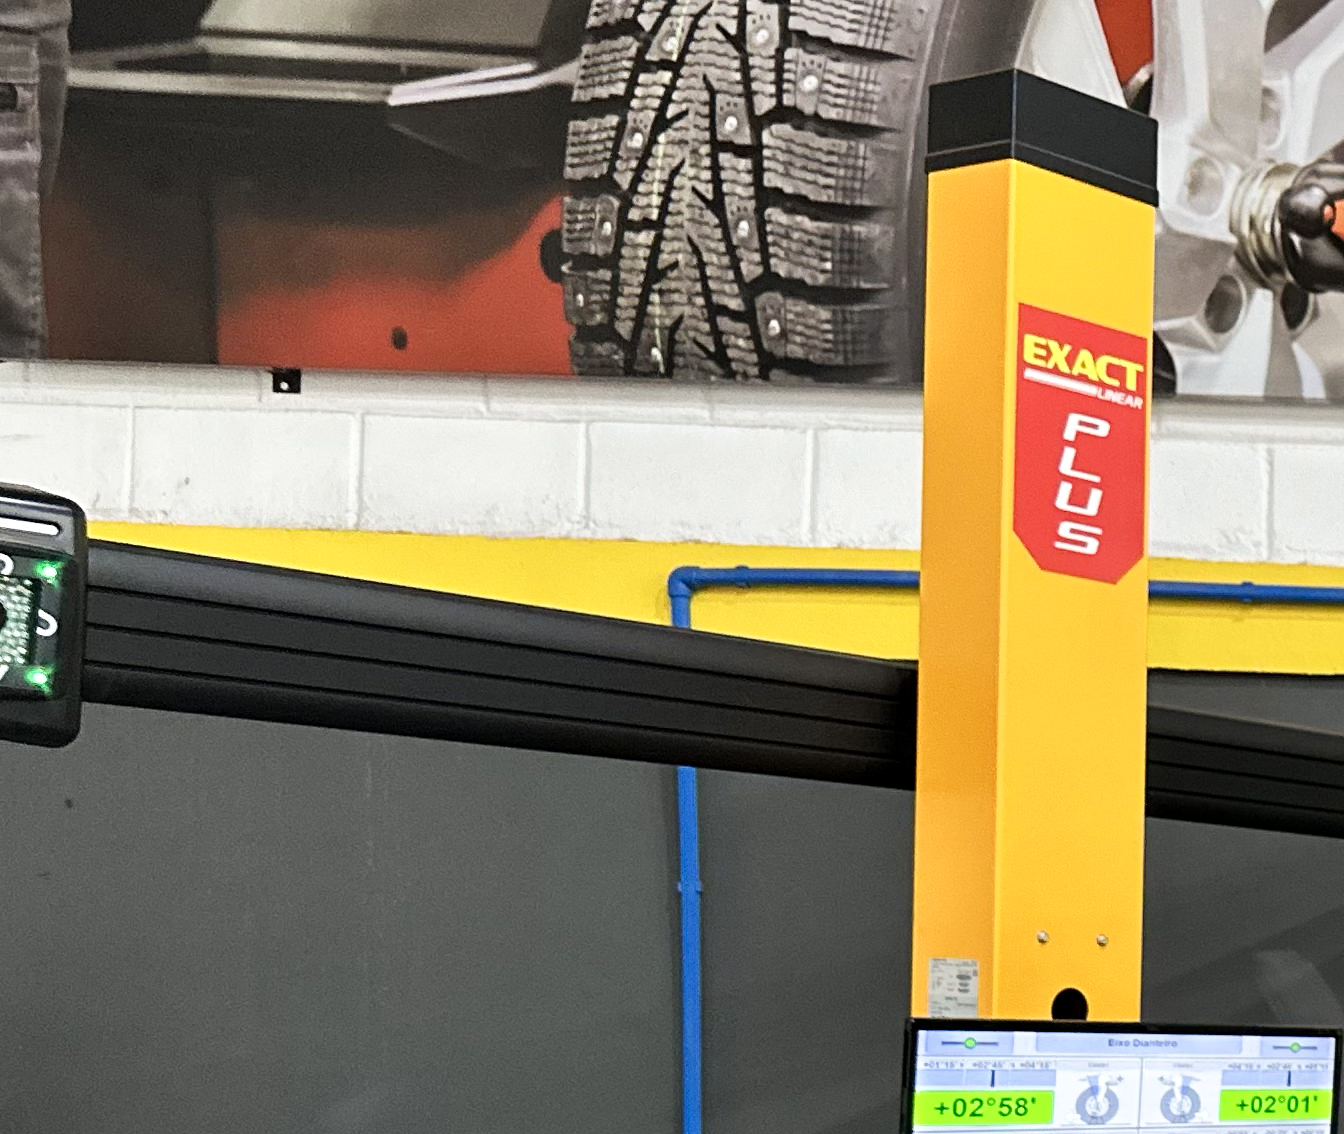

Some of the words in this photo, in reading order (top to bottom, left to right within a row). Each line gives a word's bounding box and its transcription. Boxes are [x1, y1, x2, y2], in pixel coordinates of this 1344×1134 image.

[1022, 333, 1144, 392] EXACT
[1097, 386, 1144, 410] LINEAR
[1053, 412, 1111, 555] PLUS
[934, 1097, 1037, 1118] +02°58'
[1236, 1095, 1318, 1114] +02°01'
